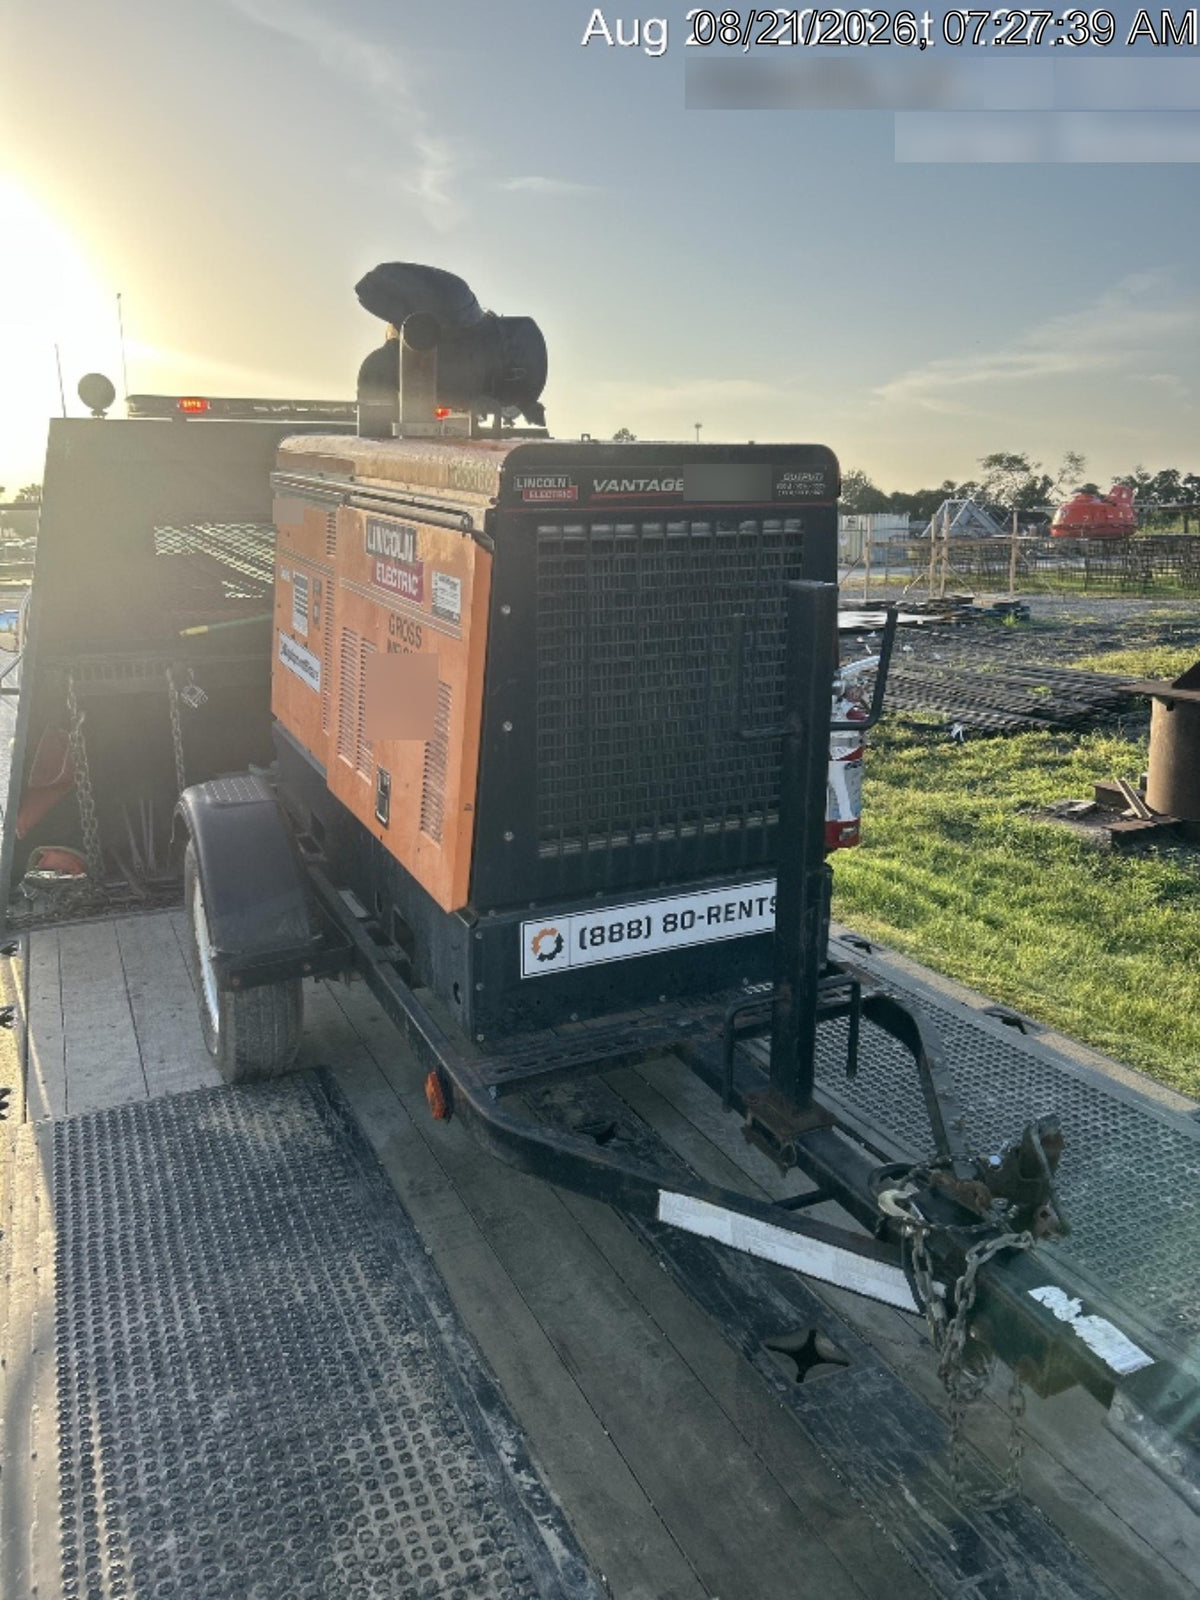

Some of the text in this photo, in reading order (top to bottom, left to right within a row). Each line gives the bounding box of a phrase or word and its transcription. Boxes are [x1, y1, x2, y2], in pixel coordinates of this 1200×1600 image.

[516, 477, 567, 488] LINCOLN
[529, 490, 572, 498] ELECTRIC
[593, 478, 684, 492] VANTAGE
[367, 523, 414, 563] LINCOLN
[376, 562, 419, 597] ELECTRIC
[388, 612, 422, 649] GROSS
[579, 915, 651, 950] (888)
